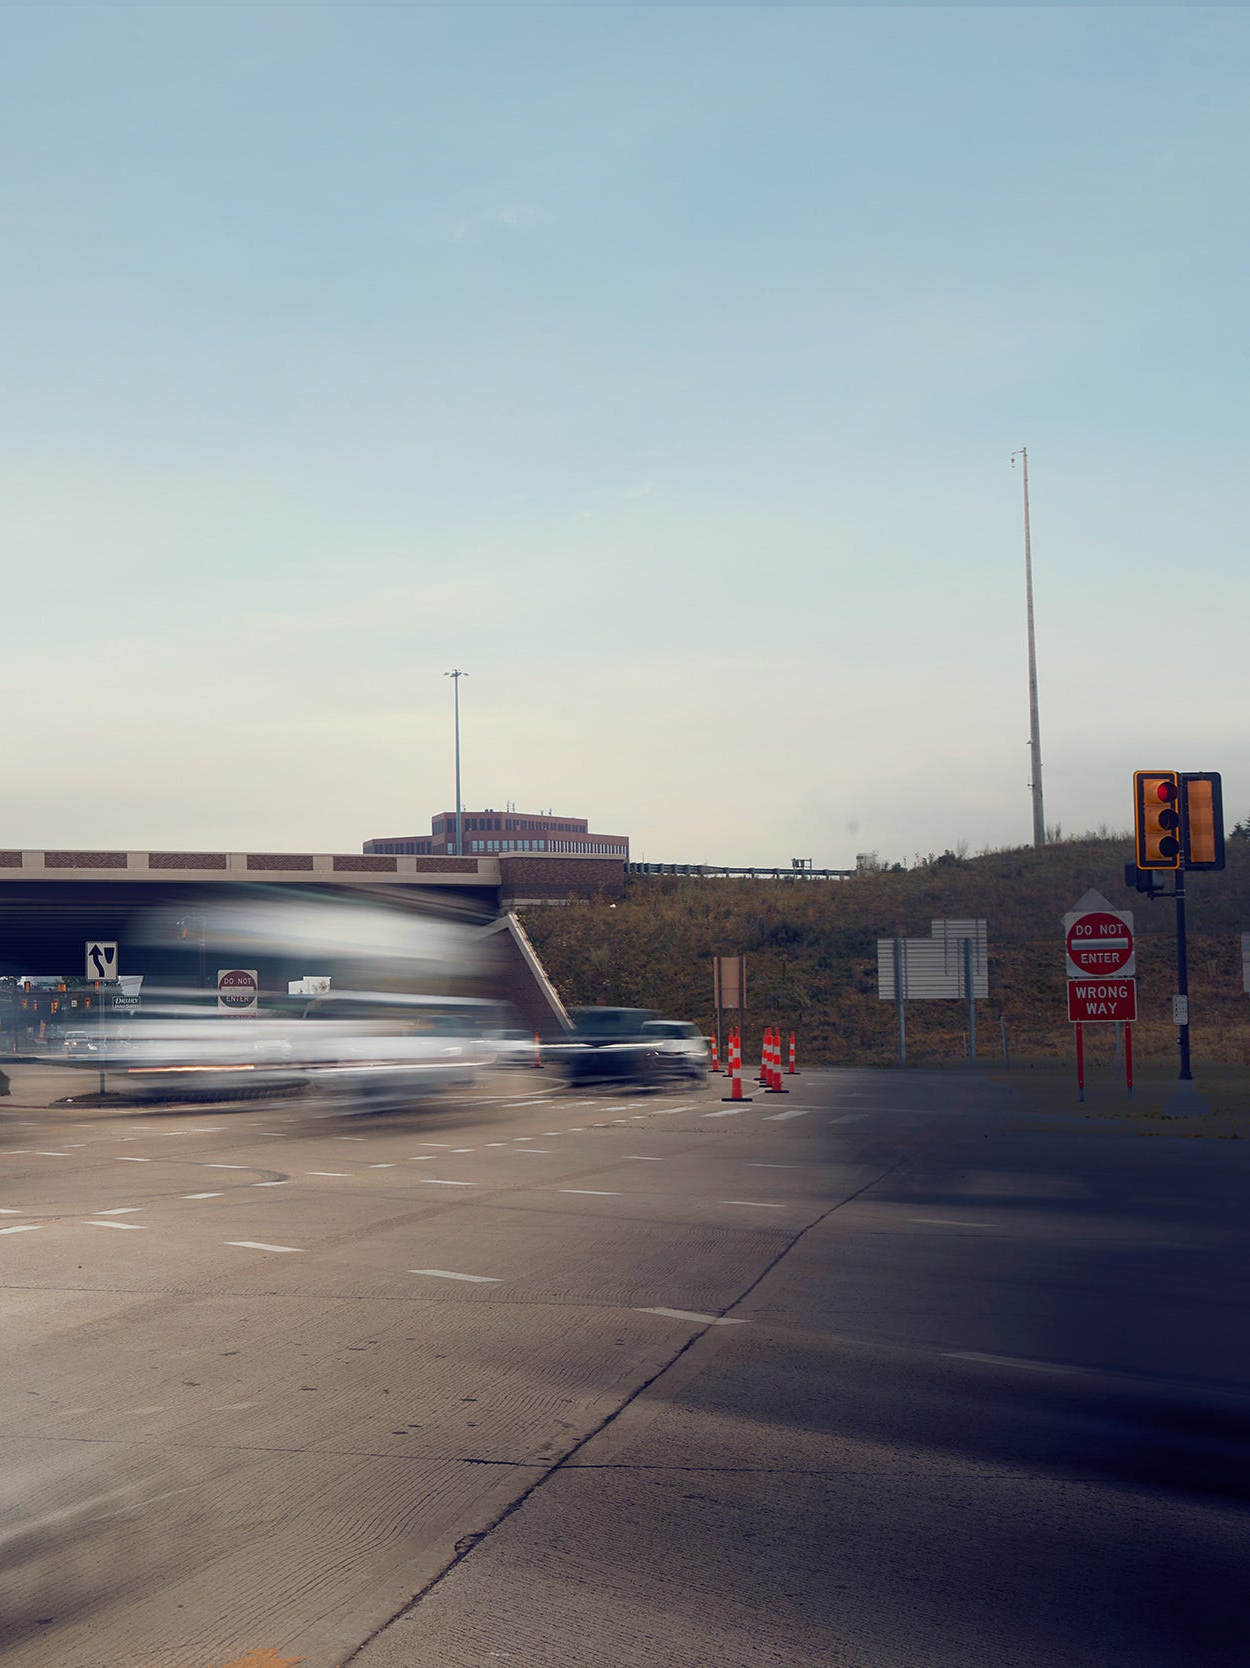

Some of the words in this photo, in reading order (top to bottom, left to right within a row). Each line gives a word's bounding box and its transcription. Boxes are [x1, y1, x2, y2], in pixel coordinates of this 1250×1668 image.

[1076, 925, 1092, 936] DO
[1099, 924, 1124, 935] NOT
[1080, 953, 1120, 964] ENTER
[1075, 985, 1128, 999] WRONG
[1086, 1002, 1118, 1015] WAY
